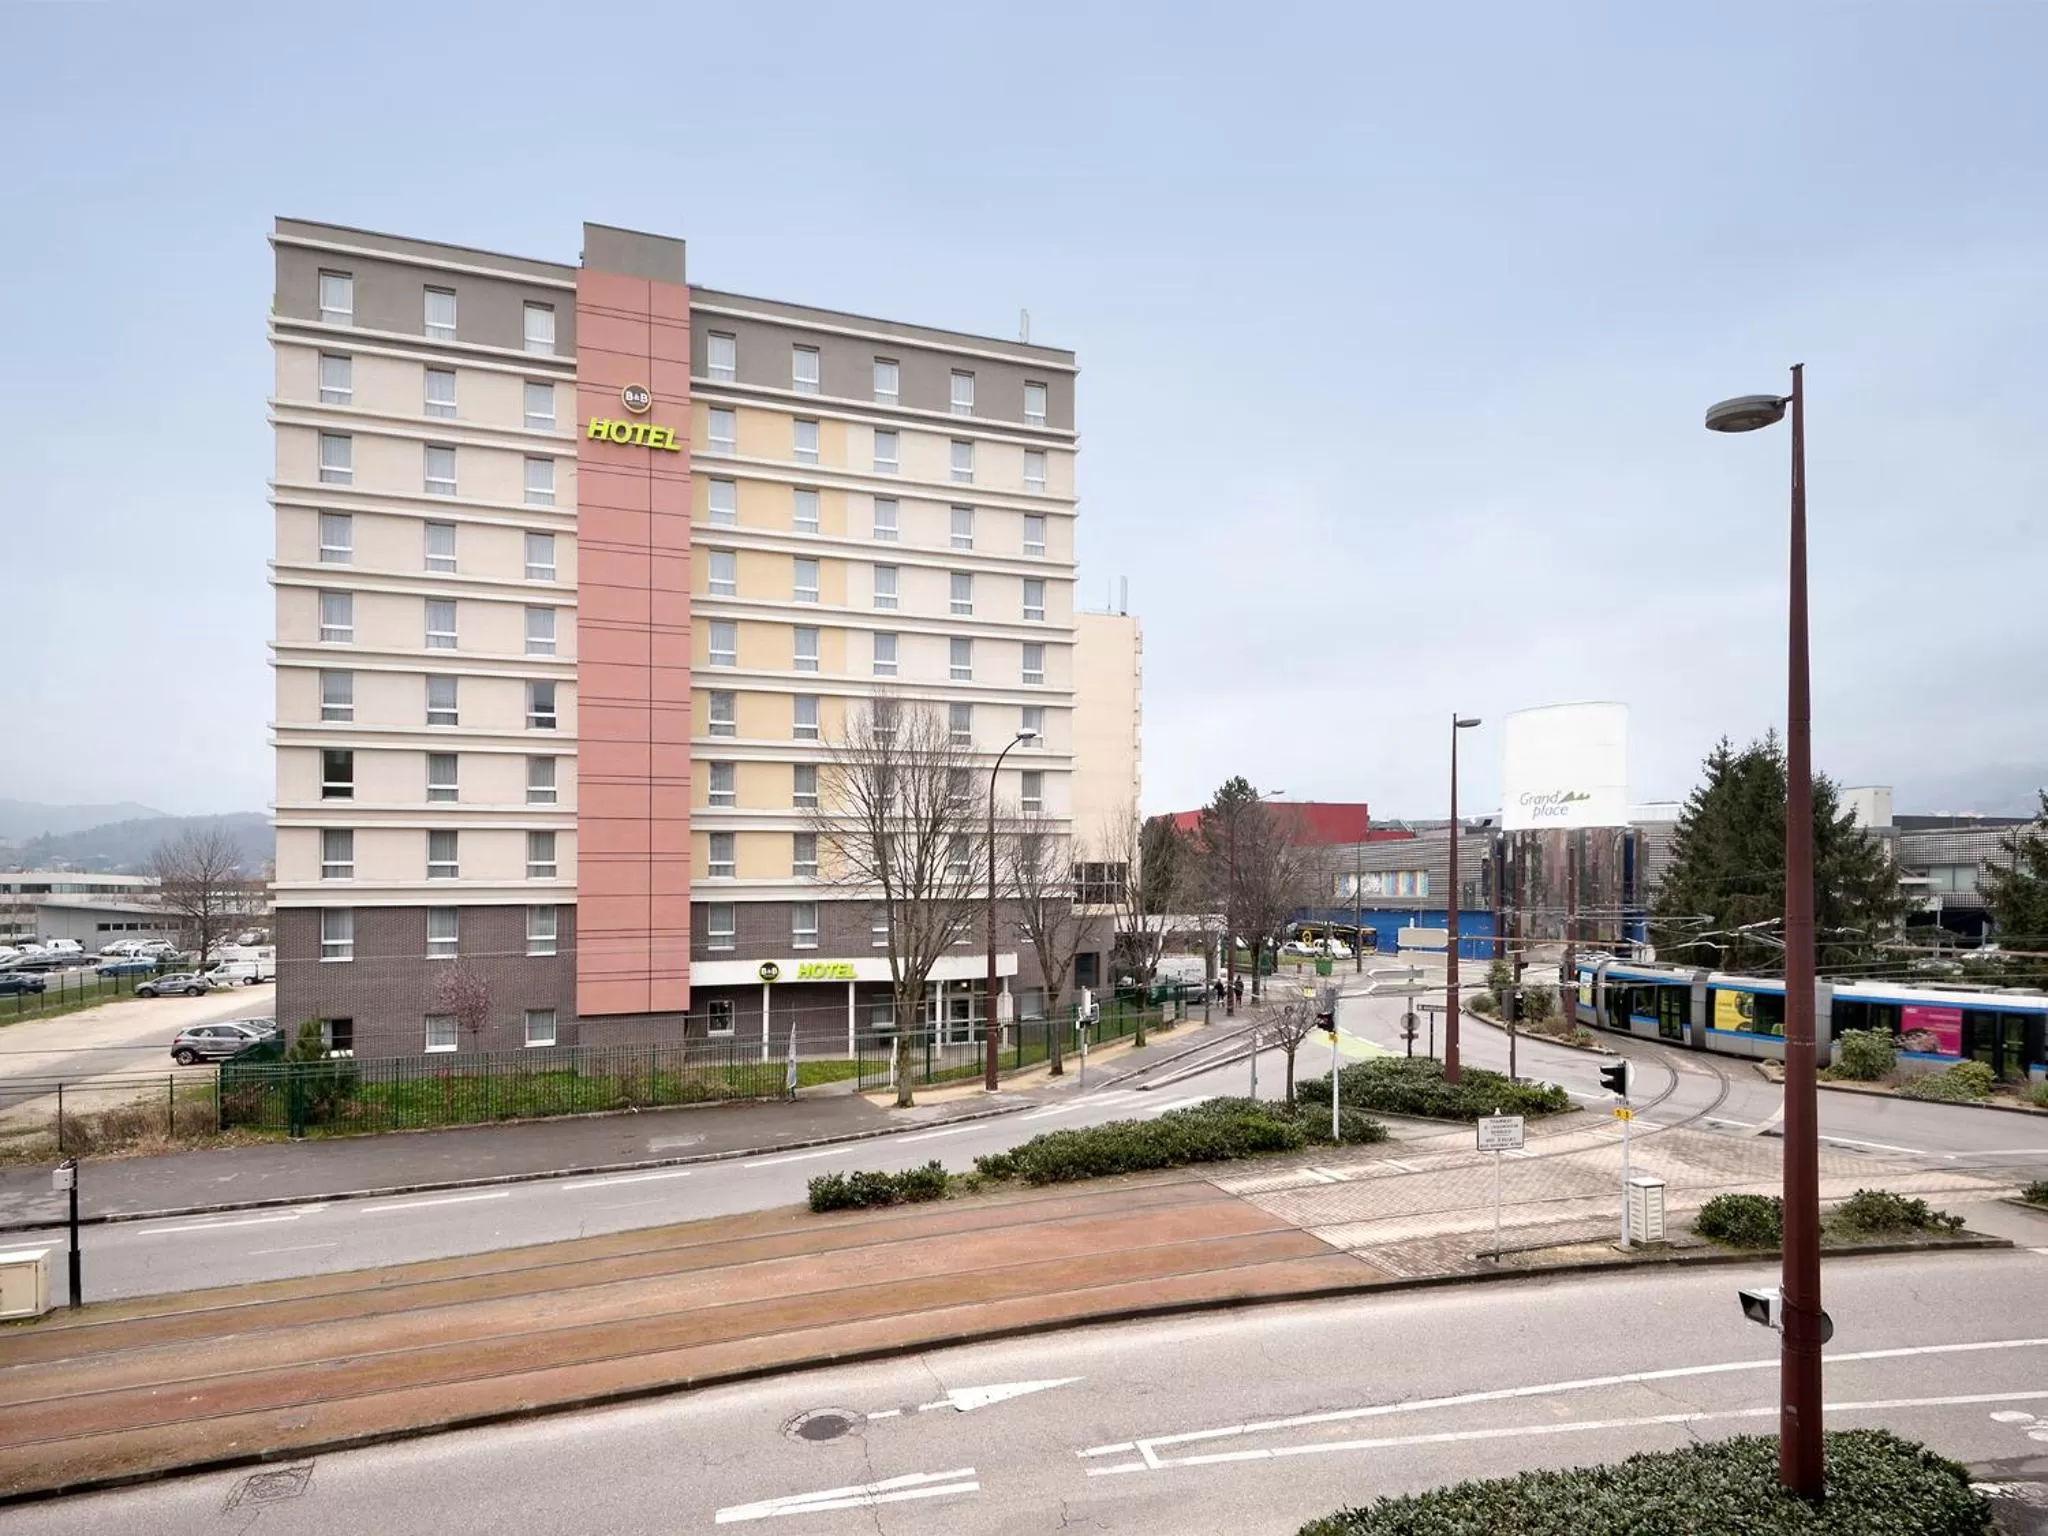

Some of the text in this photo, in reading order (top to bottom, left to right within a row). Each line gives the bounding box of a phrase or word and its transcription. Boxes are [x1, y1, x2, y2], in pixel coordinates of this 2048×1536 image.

[625, 390, 649, 404] B&B
[586, 417, 681, 452] HOTEL
[1519, 790, 1562, 806] Grand
[1531, 803, 1569, 820] place
[797, 962, 858, 979] HOTEL
